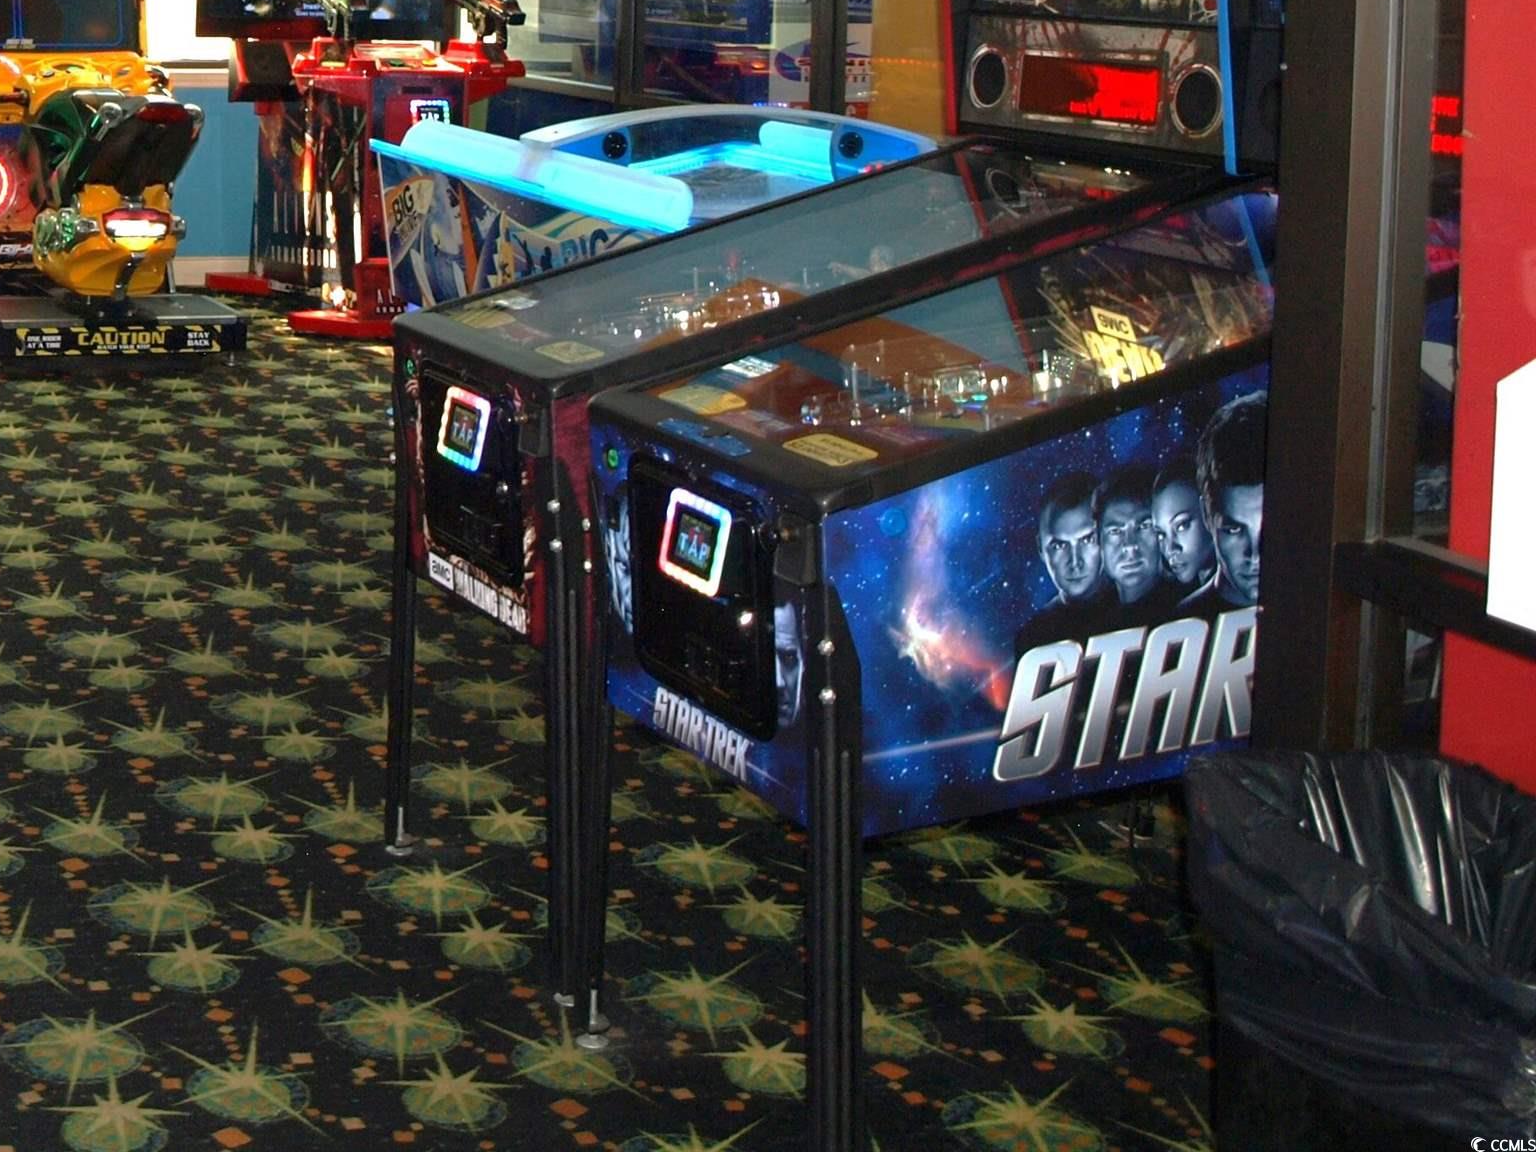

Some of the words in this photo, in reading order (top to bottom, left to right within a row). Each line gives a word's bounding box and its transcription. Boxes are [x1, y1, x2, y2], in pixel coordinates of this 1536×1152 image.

[391, 184, 414, 225] BIG
[77, 331, 166, 346] CAUTION
[186, 339, 210, 347] BACK
[677, 531, 711, 561] TAP
[652, 685, 704, 752] STAR
[704, 714, 751, 783] TREK
